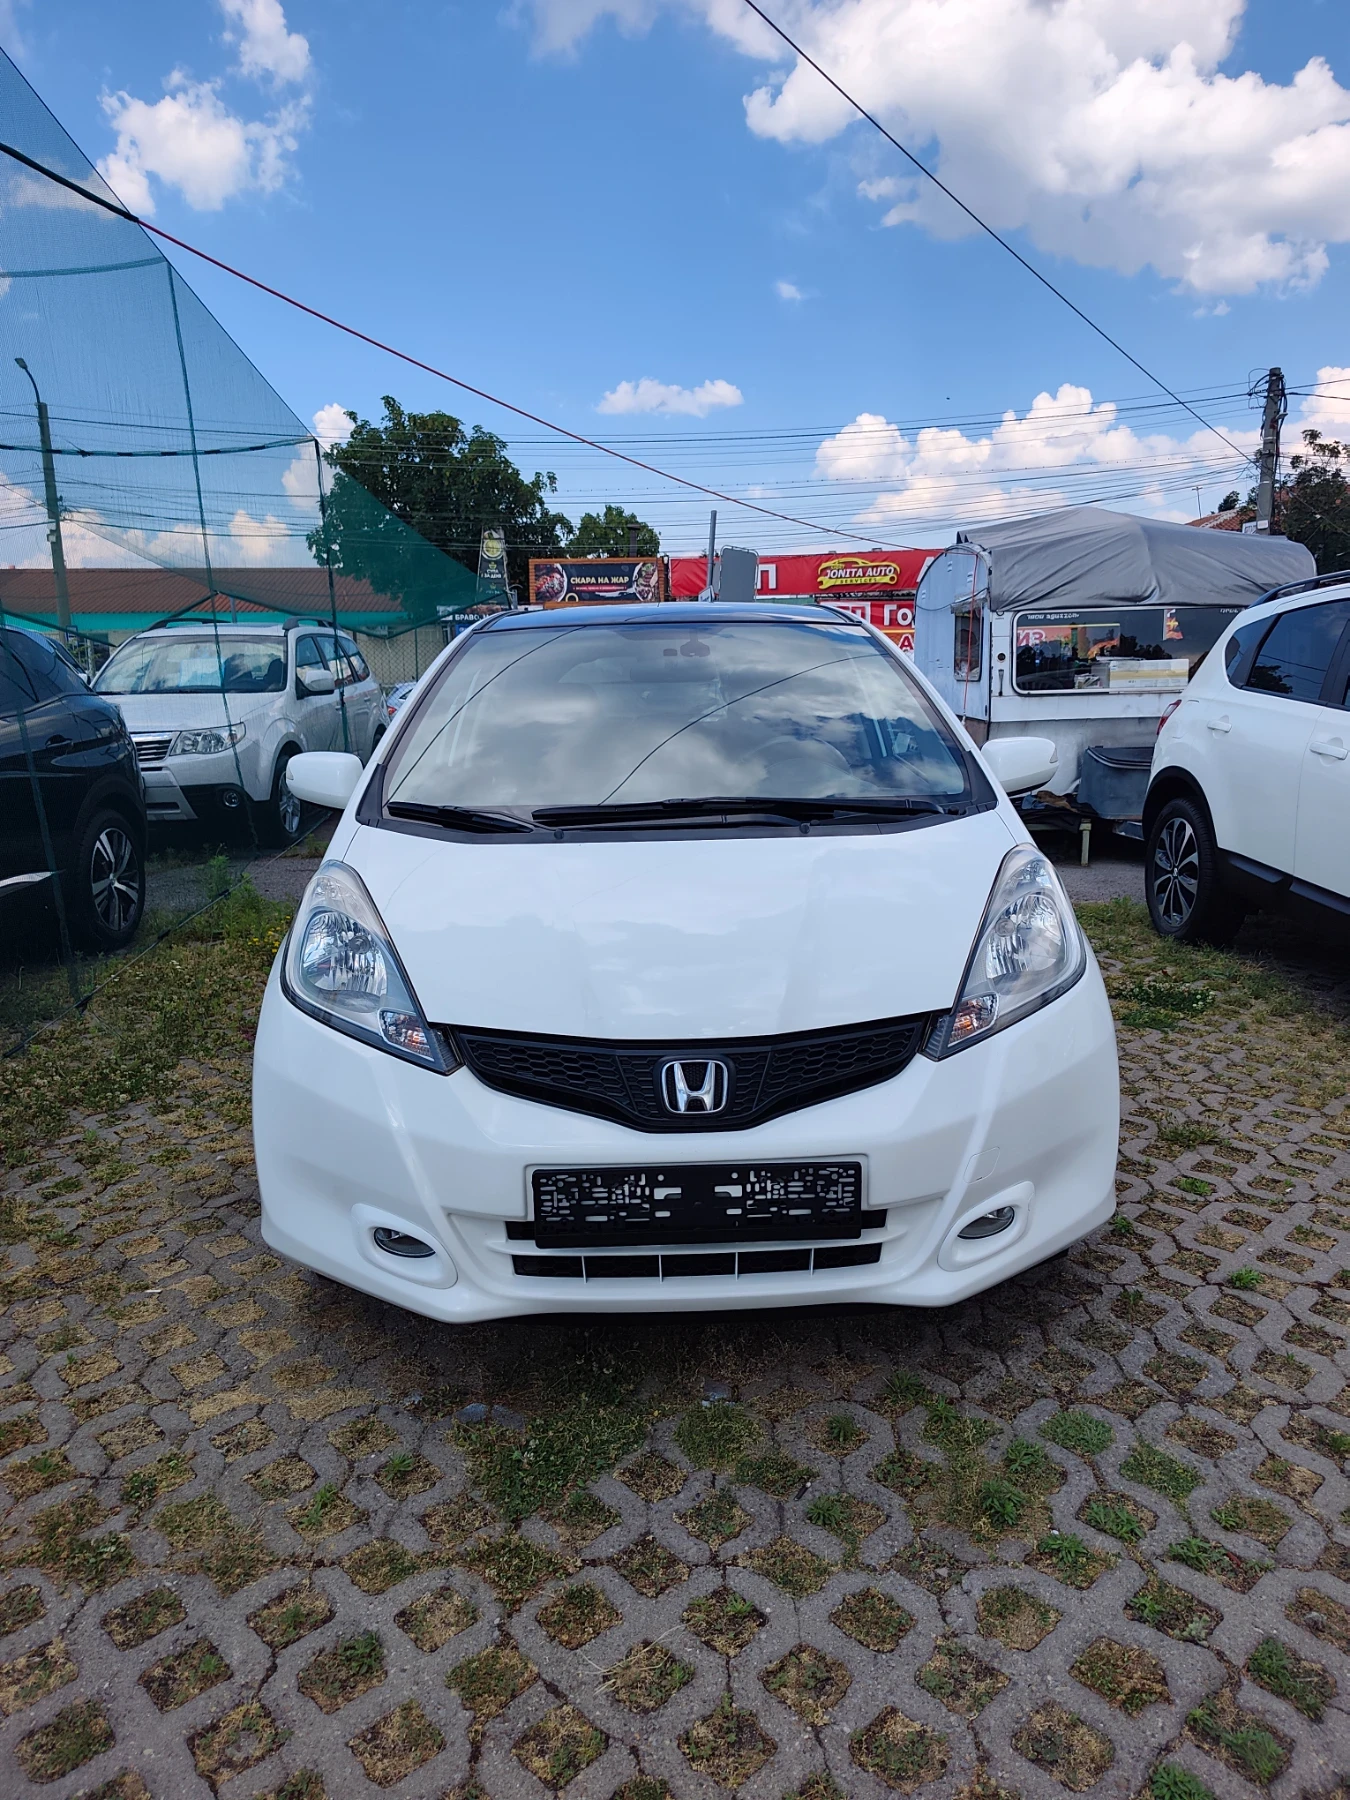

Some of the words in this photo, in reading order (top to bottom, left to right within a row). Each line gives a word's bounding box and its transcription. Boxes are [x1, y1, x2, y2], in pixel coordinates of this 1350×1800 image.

[825, 568, 863, 579] JONITA
[865, 566, 895, 577] AUTO
[611, 576, 629, 584] ЖАР
[883, 604, 914, 627] Го
